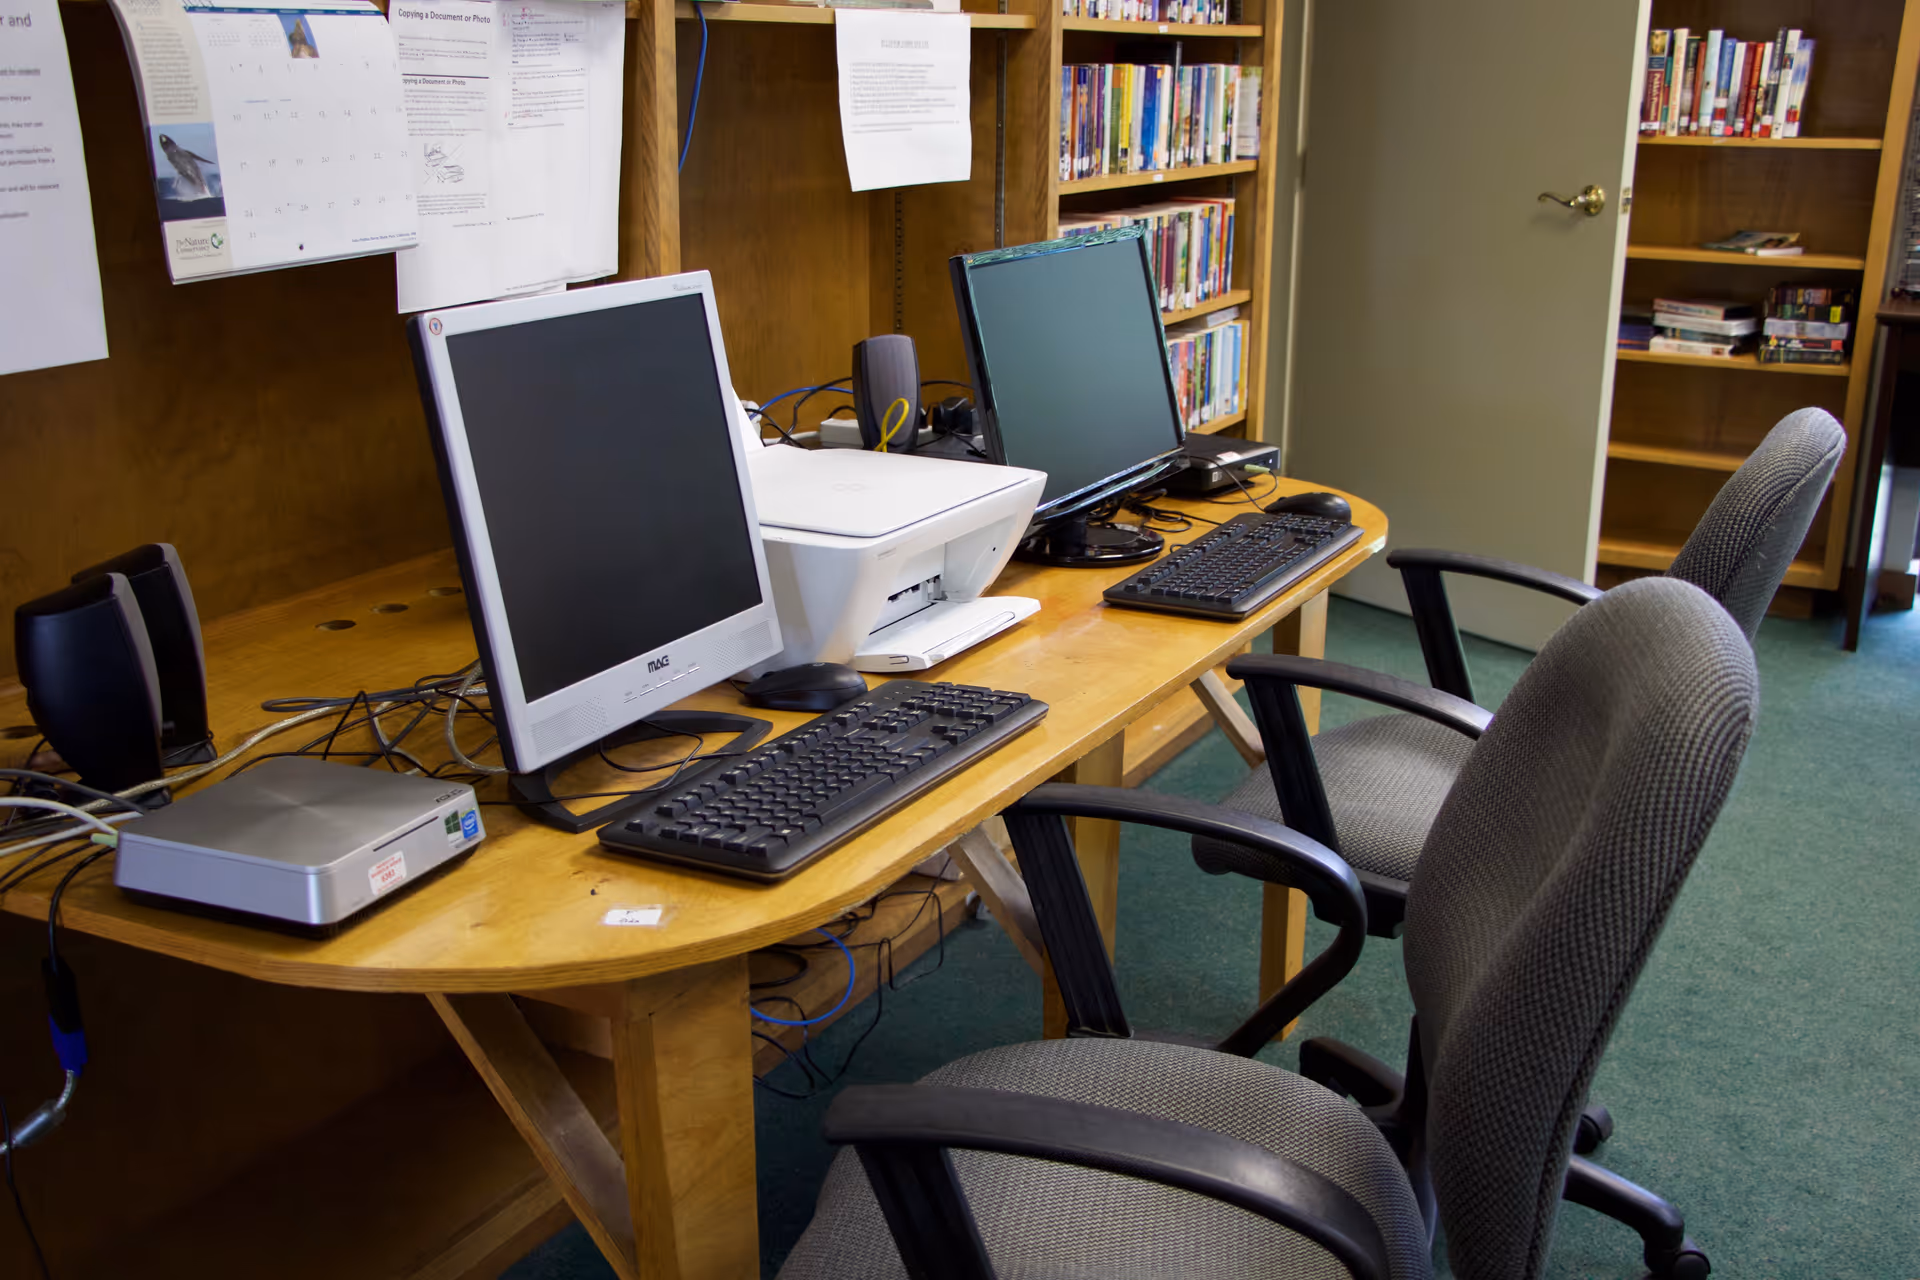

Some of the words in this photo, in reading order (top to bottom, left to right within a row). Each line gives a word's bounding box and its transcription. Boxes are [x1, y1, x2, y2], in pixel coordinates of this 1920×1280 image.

[8, 11, 32, 27] and
[398, 8, 424, 20] Copying
[430, 11, 463, 22] Document
[472, 14, 491, 24] Photo
[185, 237, 209, 246] Nature
